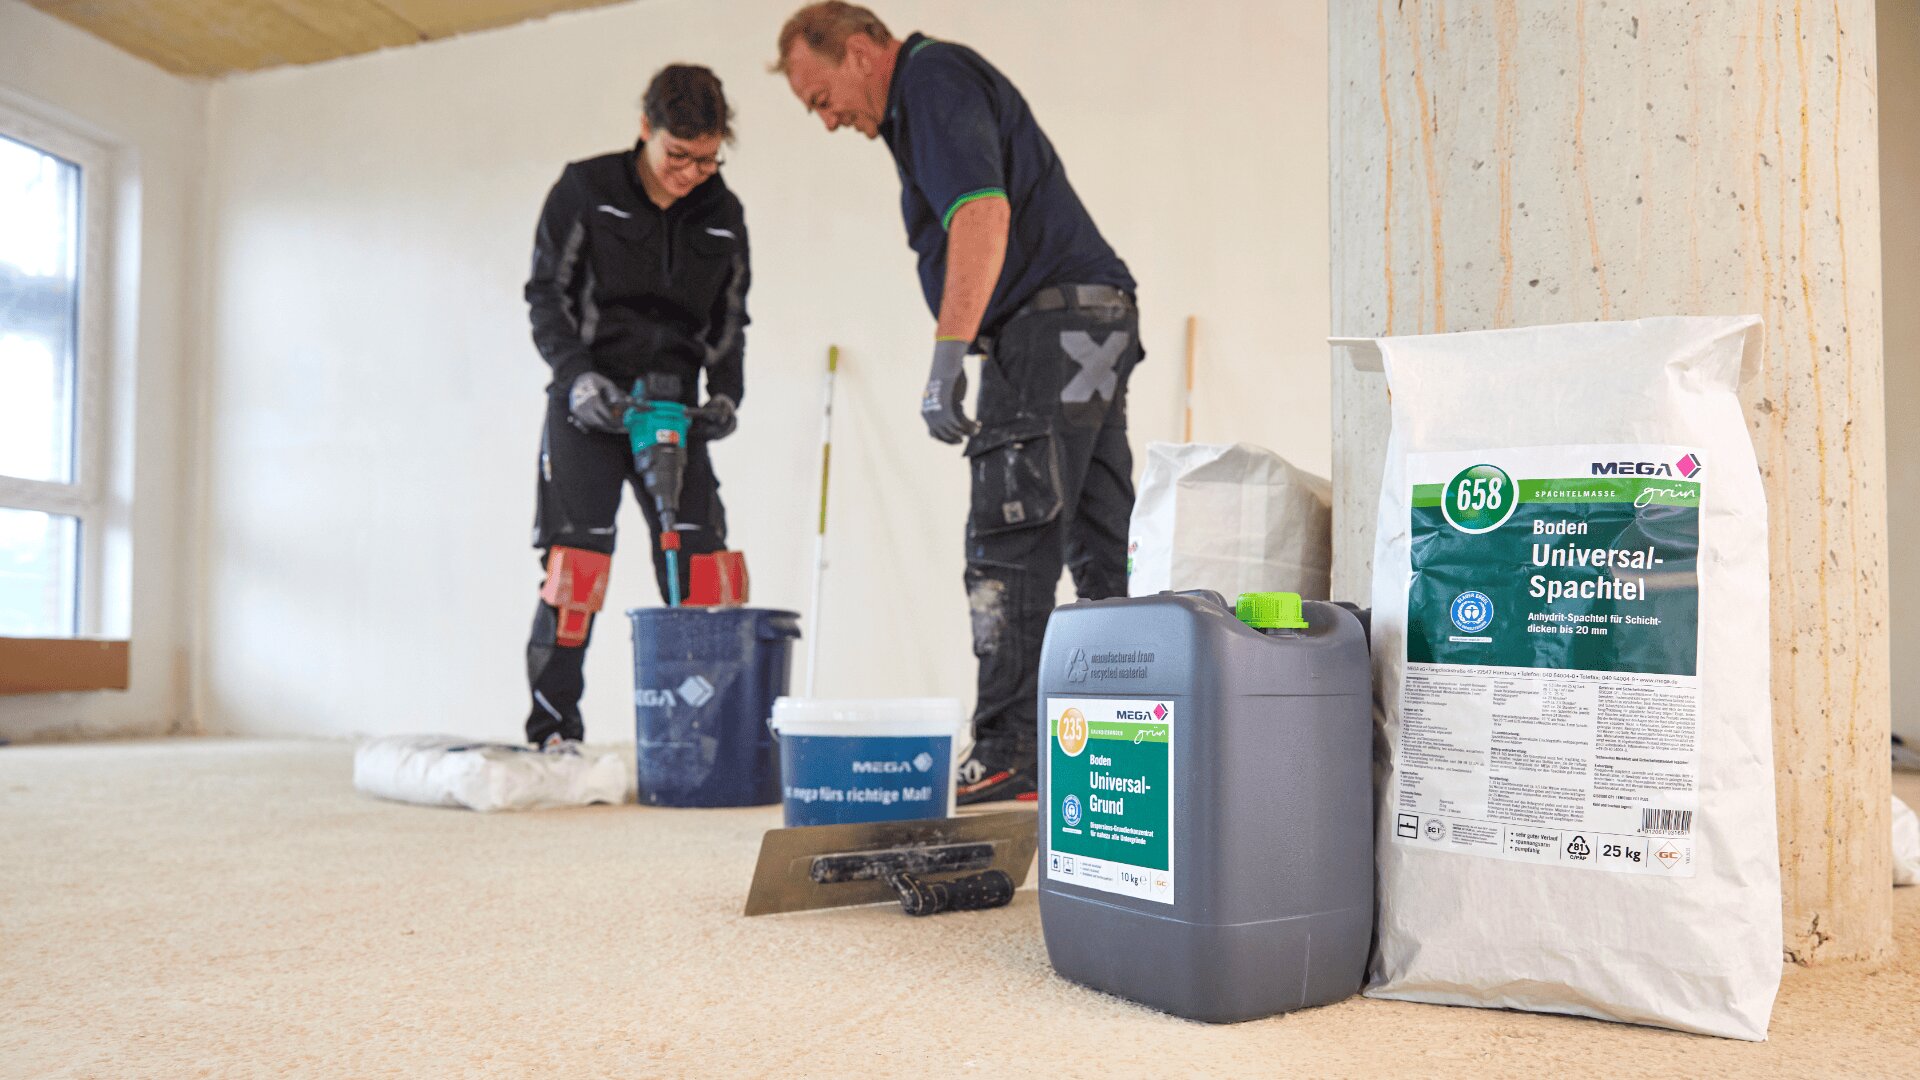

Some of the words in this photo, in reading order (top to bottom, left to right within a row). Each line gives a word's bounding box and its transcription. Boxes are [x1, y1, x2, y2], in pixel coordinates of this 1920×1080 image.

[1591, 462, 1673, 476] MEGA
[1457, 477, 1502, 511] 658
[1535, 490, 1616, 498] SPACHTELMASSE
[1633, 483, 1696, 508] grün
[1533, 519, 1588, 535] Boden
[1532, 542, 1664, 570] Universal-
[1529, 574, 1645, 604] Spachtel
[1527, 612, 1607, 624] Anhydrit-Spachtel
[1609, 614, 1623, 624] für
[1625, 615, 1662, 625] Schicht-
[1527, 624, 1557, 633] dicken
[1559, 625, 1574, 634] bis
[1575, 625, 1589, 635] 20
[1591, 627, 1608, 635] mm
[1091, 650, 1136, 664] manufactured
[1137, 650, 1155, 663] from
[1090, 667, 1117, 680] recycled
[1118, 666, 1148, 679] material
[636, 690, 677, 707] EGA
[1116, 710, 1151, 721] MEGA
[1063, 717, 1082, 741] 235
[1133, 726, 1166, 745] grün
[852, 761, 912, 774] MEGA
[1089, 754, 1111, 767] Boden
[1089, 771, 1151, 795] Universal-
[846, 786, 899, 805] richtige
[1089, 794, 1124, 816] Grund
[1573, 843, 1584, 851] 81
[1602, 844, 1622, 858] 25
[1625, 846, 1641, 863] kg
[1658, 851, 1679, 859] GC
[1121, 871, 1130, 882] 10
[1130, 873, 1139, 886] kg
